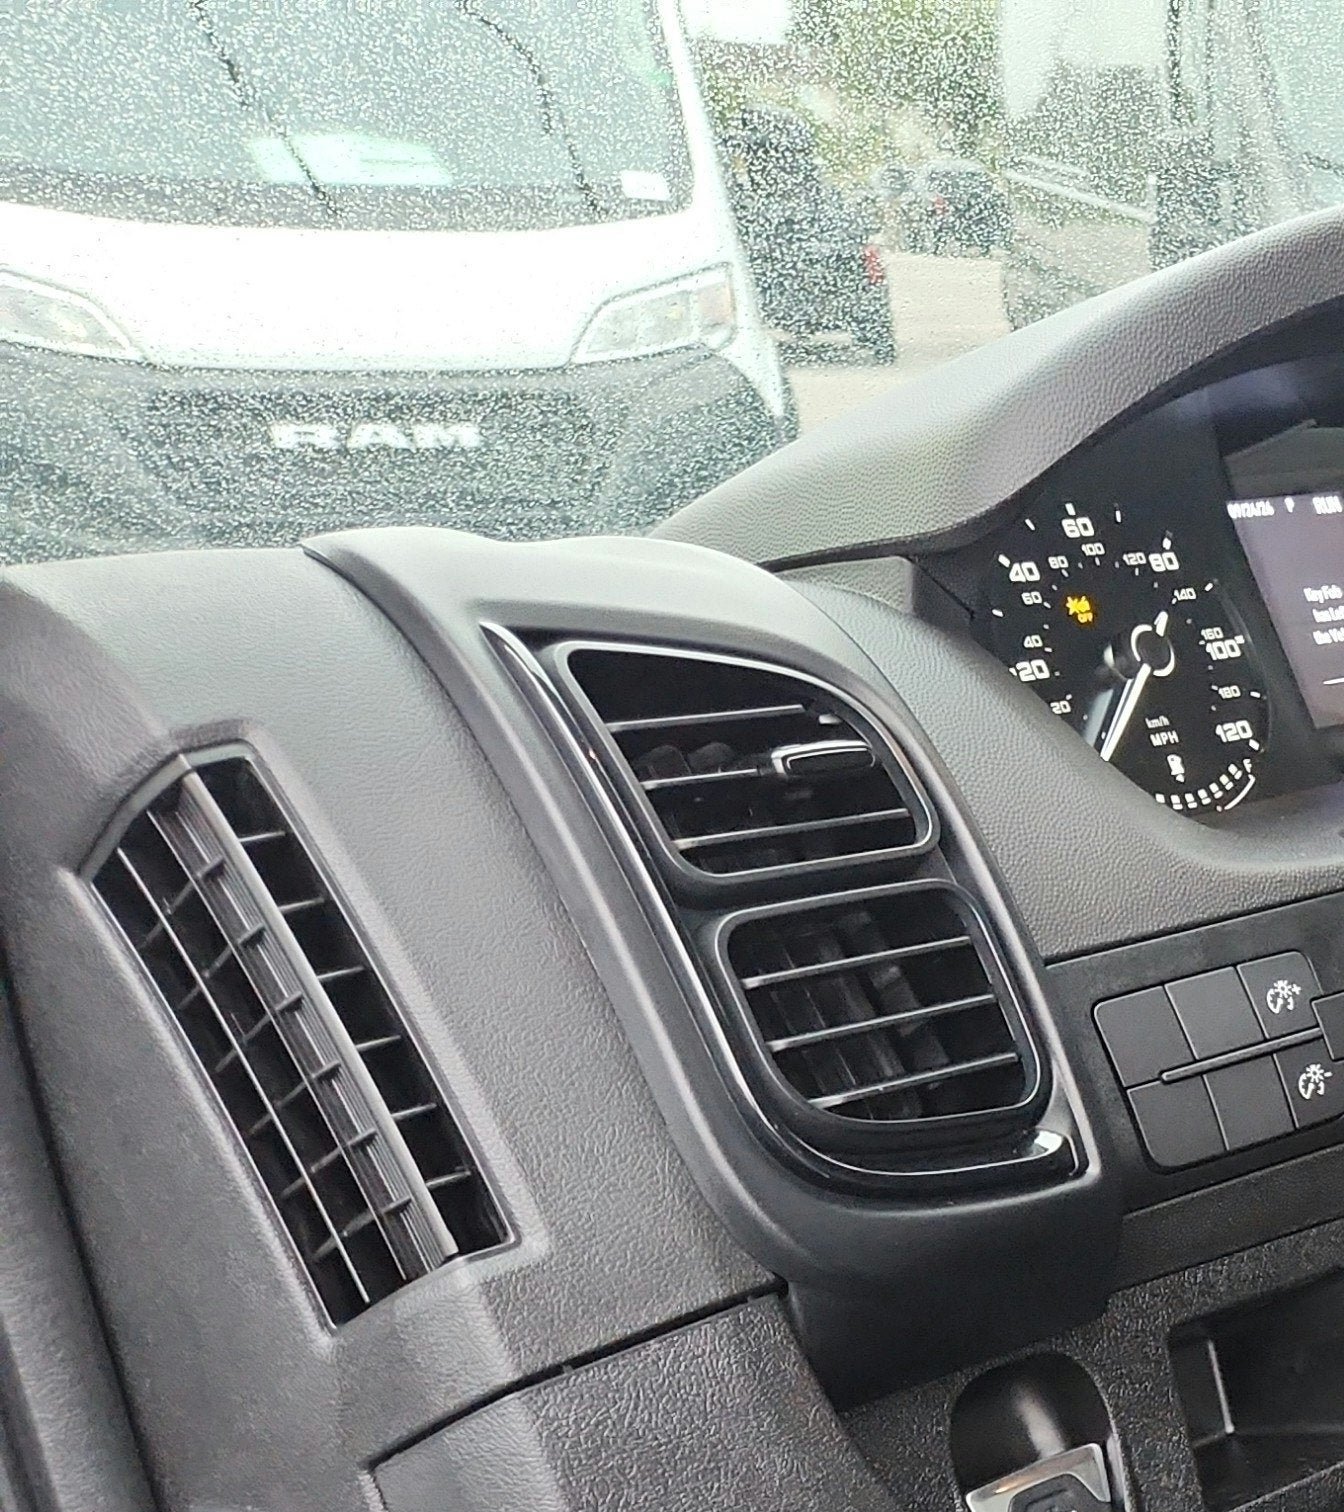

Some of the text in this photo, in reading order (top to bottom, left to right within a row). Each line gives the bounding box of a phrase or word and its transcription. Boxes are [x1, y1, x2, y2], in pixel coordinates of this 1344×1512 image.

[270, 421, 484, 449] RAM
[1312, 496, 1342, 514] RUN
[1062, 516, 1095, 538] 60
[1081, 542, 1105, 556] 100
[1048, 555, 1069, 569] 80
[1123, 552, 1147, 566] 120
[1148, 551, 1180, 572] 80
[1009, 561, 1040, 582] 40
[1021, 591, 1042, 605] 60
[1174, 587, 1197, 600] 140
[1201, 626, 1224, 640] 160
[1023, 634, 1043, 648] 40
[1206, 639, 1241, 660] 100
[1016, 659, 1050, 682] 20
[1218, 686, 1241, 699] 180
[1050, 701, 1071, 714] 20
[1145, 715, 1170, 728] km/h
[1215, 720, 1252, 742] 120
[1149, 730, 1179, 747] MPH
